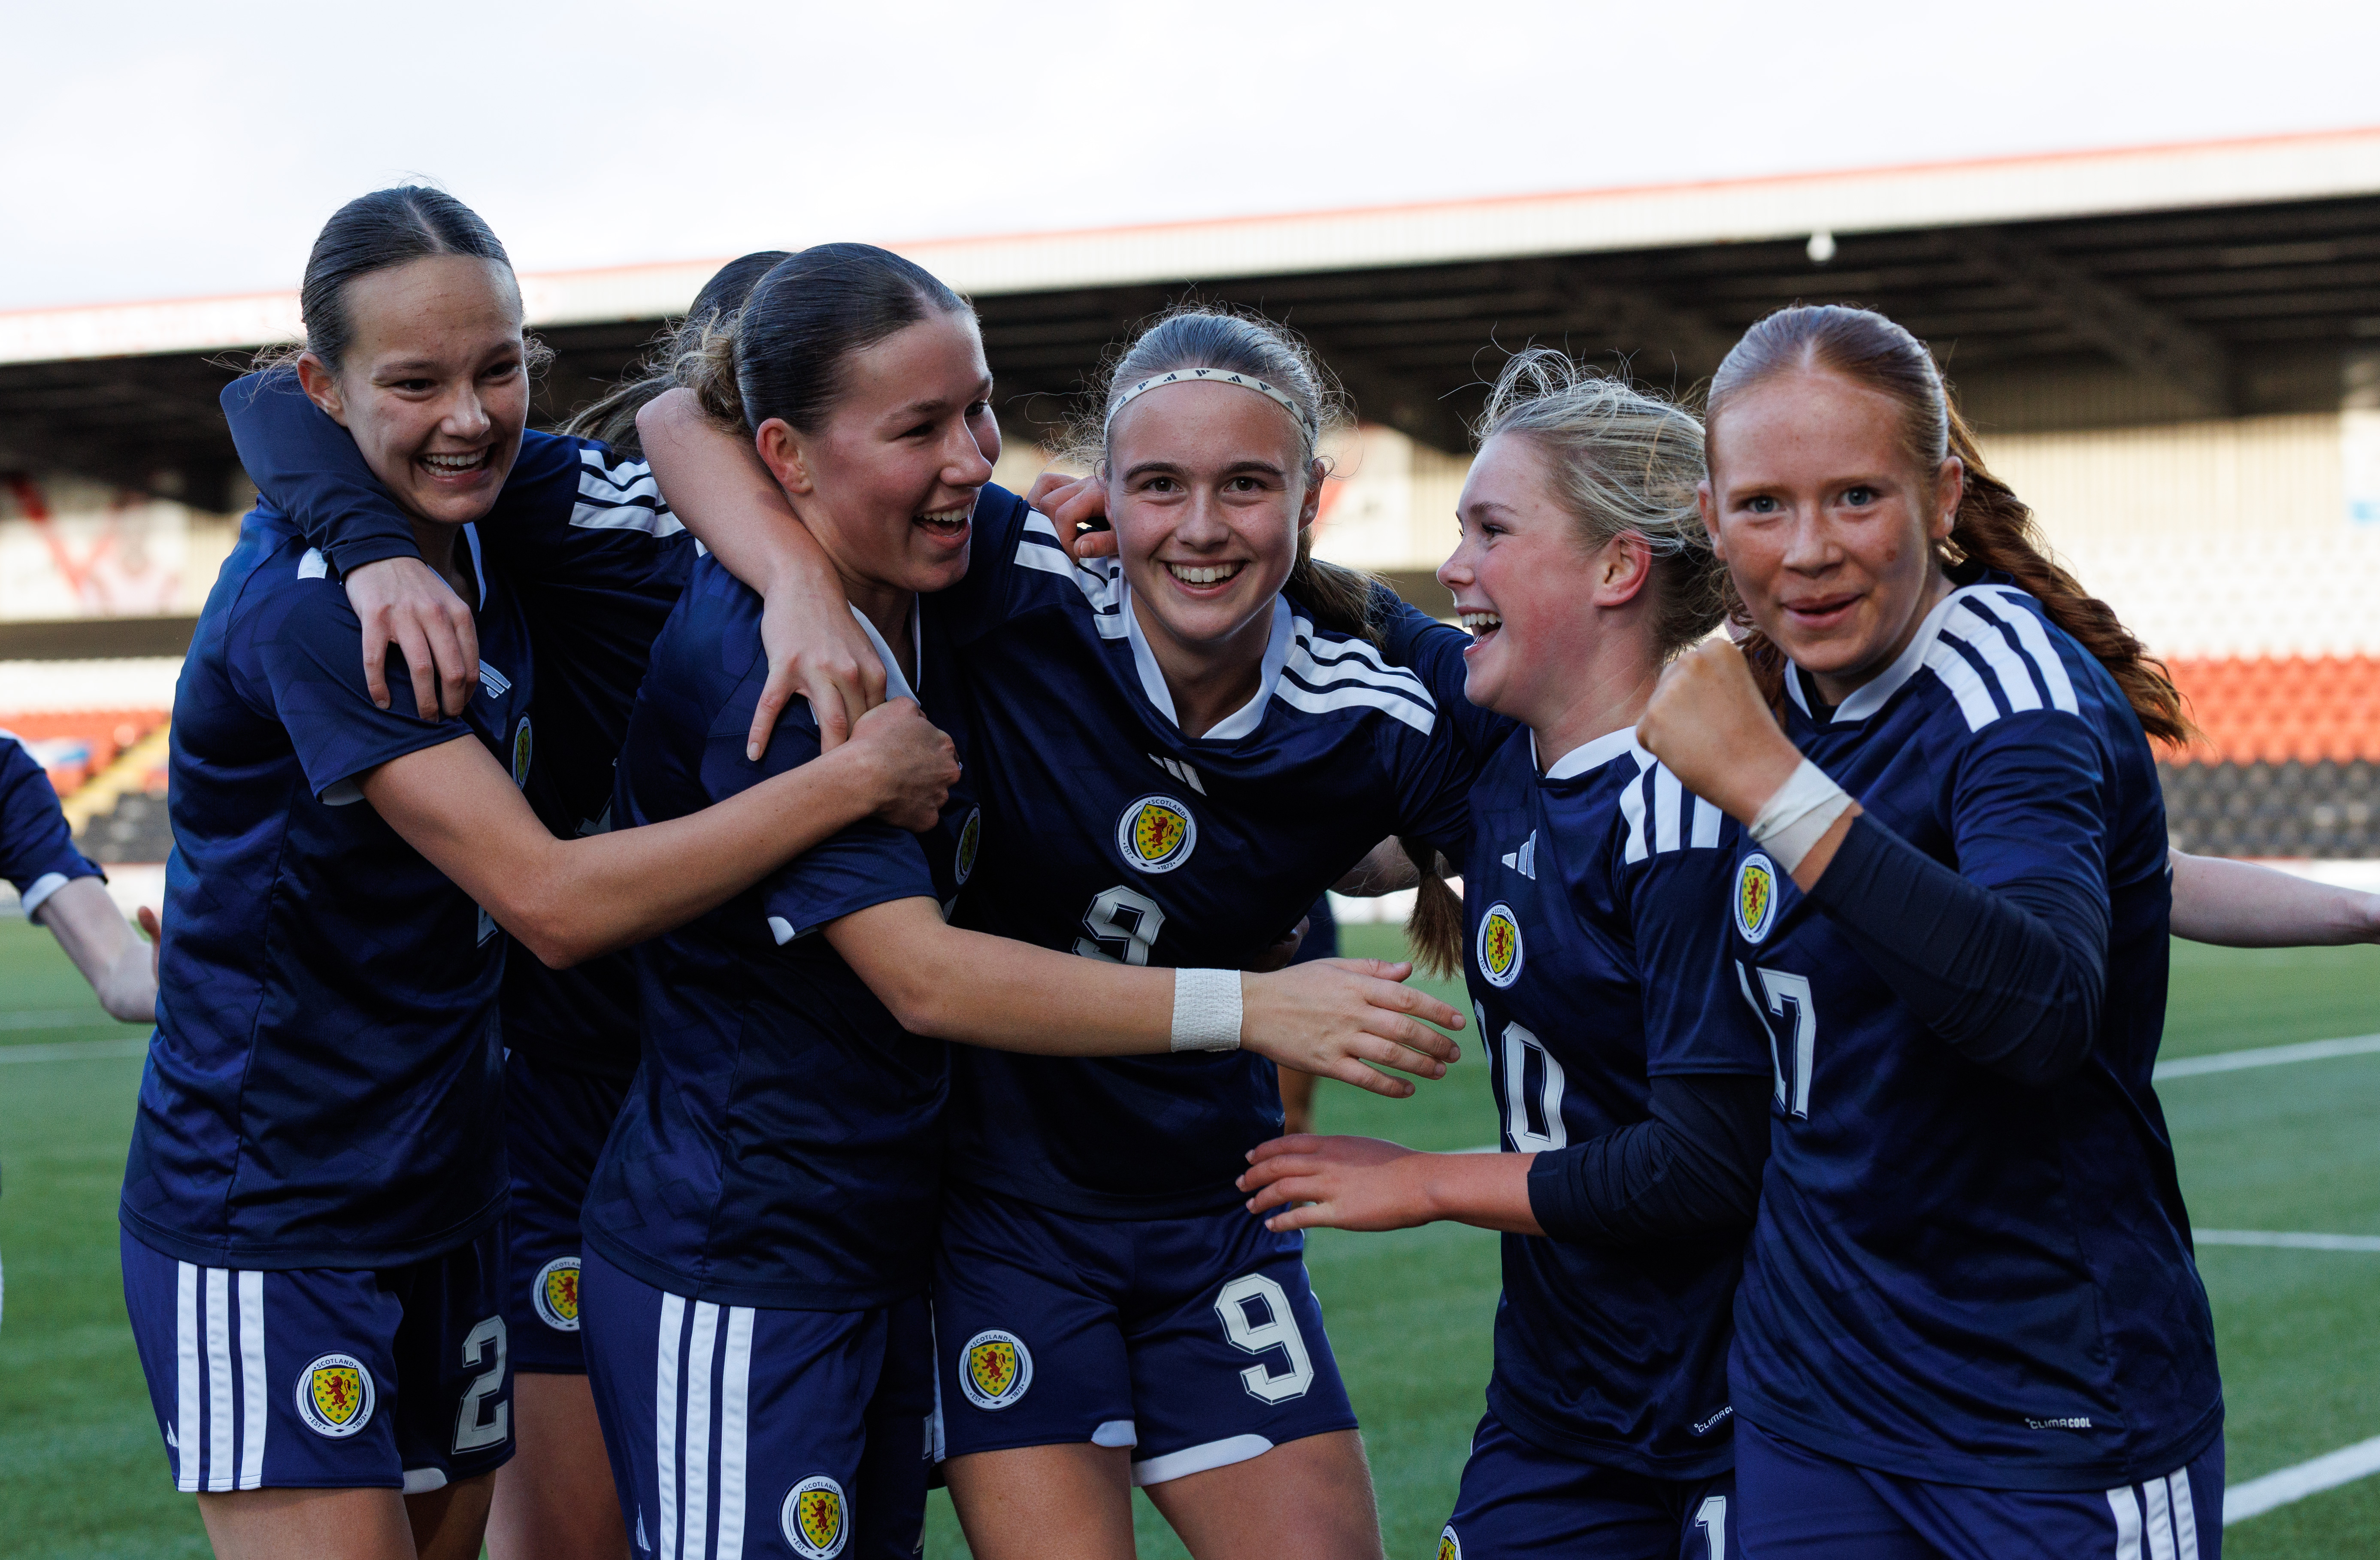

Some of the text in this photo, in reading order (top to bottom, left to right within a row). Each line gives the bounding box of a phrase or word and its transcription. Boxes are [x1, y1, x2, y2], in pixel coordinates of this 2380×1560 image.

[1151, 799, 1185, 817] SCOTLAND
[1123, 845, 1132, 856] EST
[1749, 858, 1770, 872] SCOTLAND
[1495, 908, 1514, 923] SCOTLAND
[1072, 885, 1166, 967] 9
[1505, 974, 1513, 983] 1873
[545, 1314, 554, 1323] EST
[972, 1334, 1008, 1346] SCOTLAND
[1214, 1273, 1314, 1405] 9
[316, 1358, 354, 1369] SCOTLAND
[451, 1315, 507, 1454] 2
[1012, 1386, 1023, 1397] 1873
[971, 1394, 981, 1403] EST
[311, 1419, 322, 1428] EST
[354, 1416, 366, 1428] 1873
[804, 1481, 836, 1492] SCOTLAND
[795, 1540, 805, 1551] EST
[833, 1542, 842, 1554] 1873
